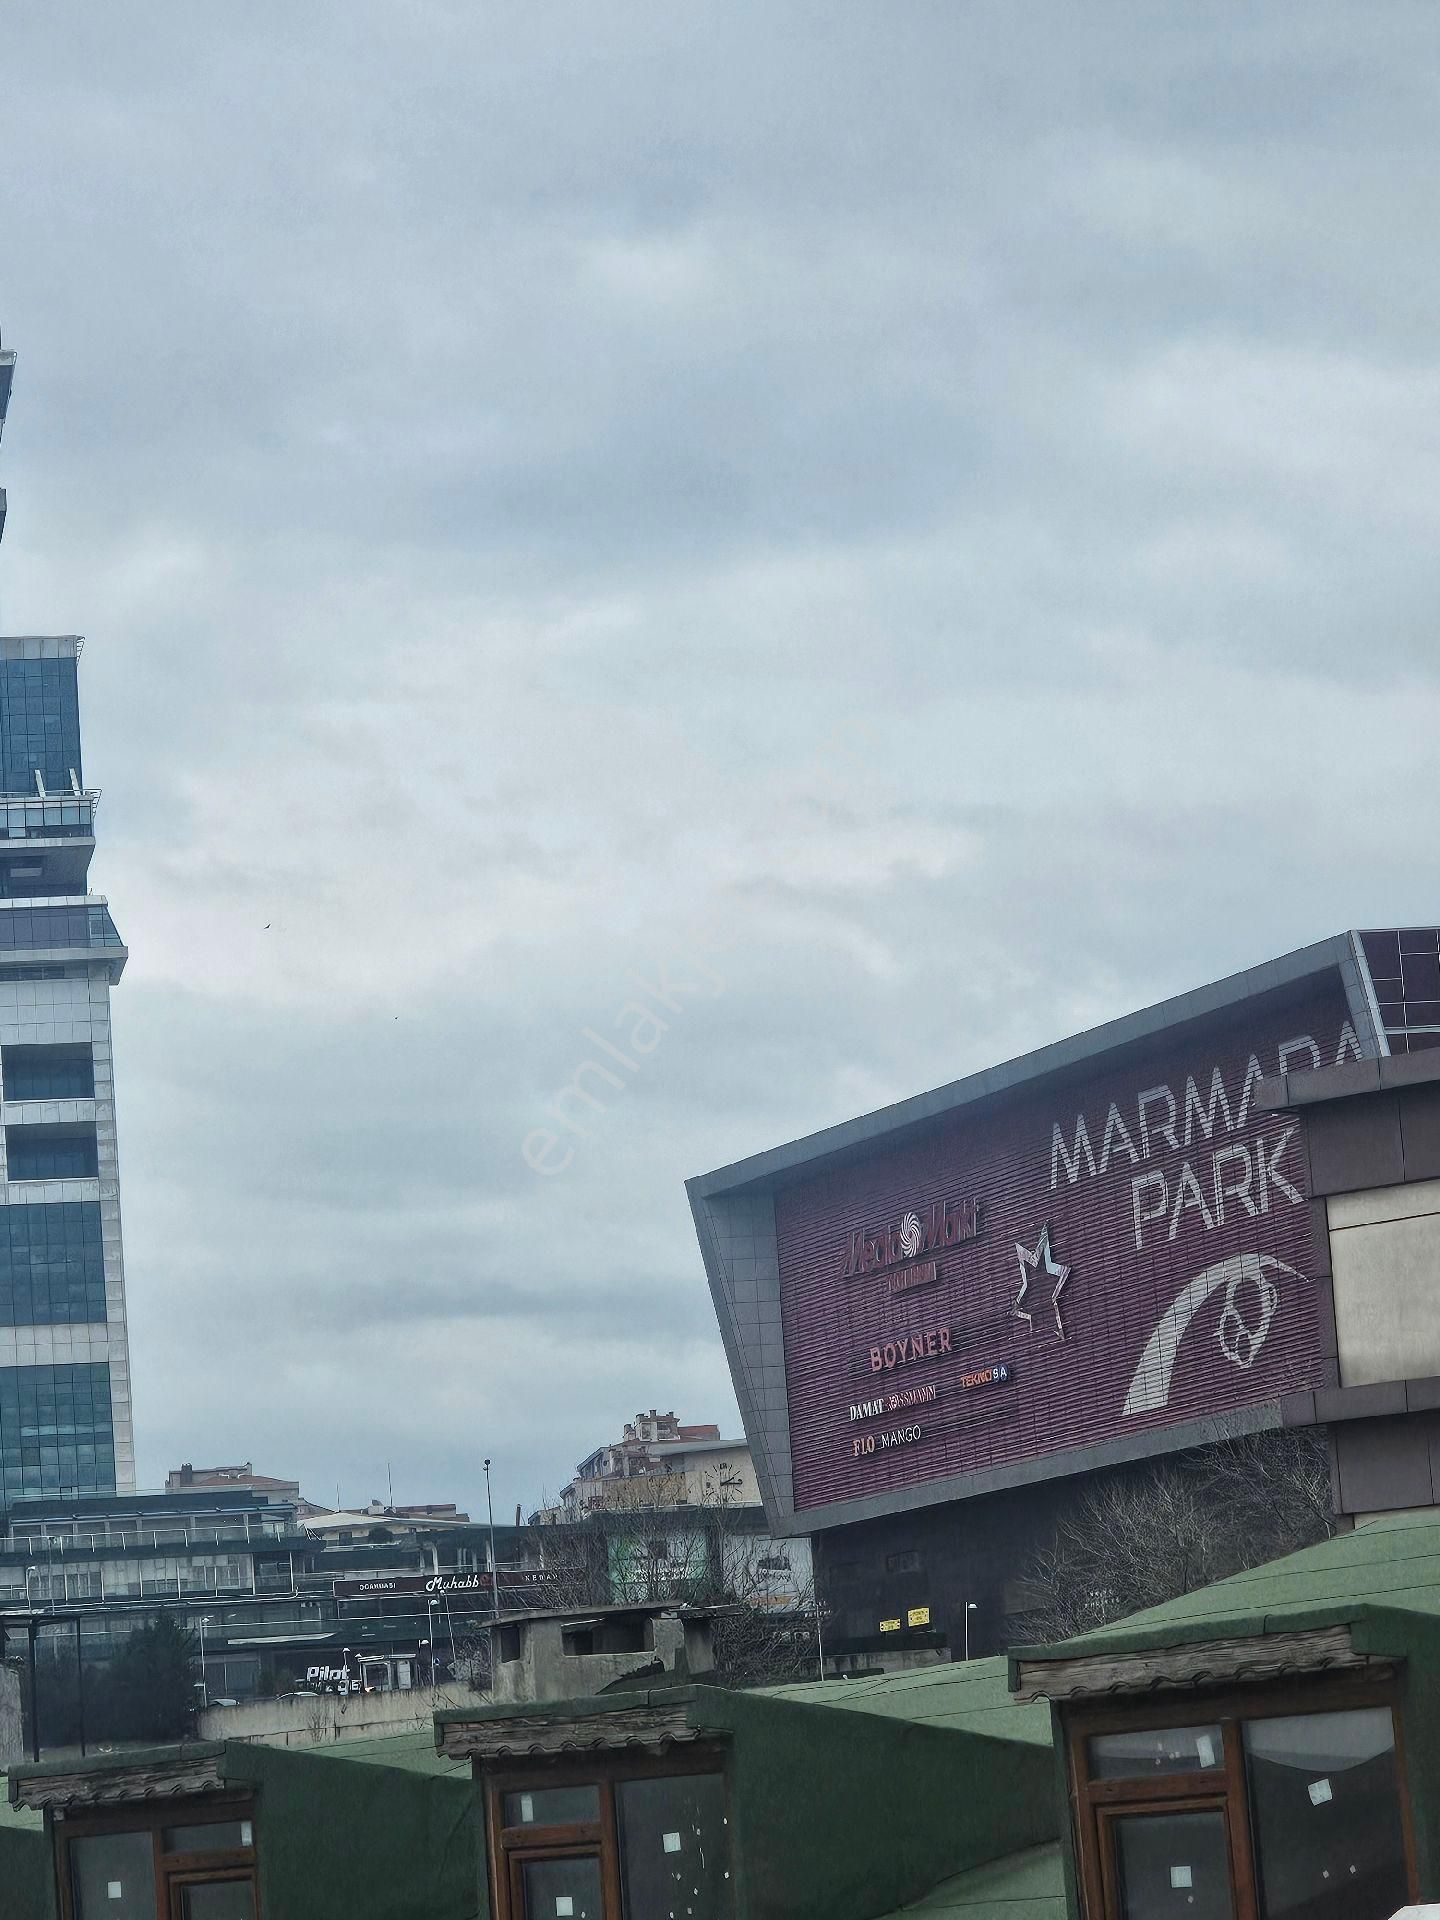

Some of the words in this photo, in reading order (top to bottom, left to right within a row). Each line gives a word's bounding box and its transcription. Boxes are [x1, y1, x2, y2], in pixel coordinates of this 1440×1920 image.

[1131, 1127, 1305, 1250] PARK
[869, 1328, 951, 1372] BOYNER
[961, 1366, 1008, 1388] TEKNOSA
[850, 1398, 884, 1421] DAMAT
[852, 1436, 876, 1457] FLO
[881, 1425, 921, 1449] MANGO
[306, 1664, 351, 1682] Pilot
